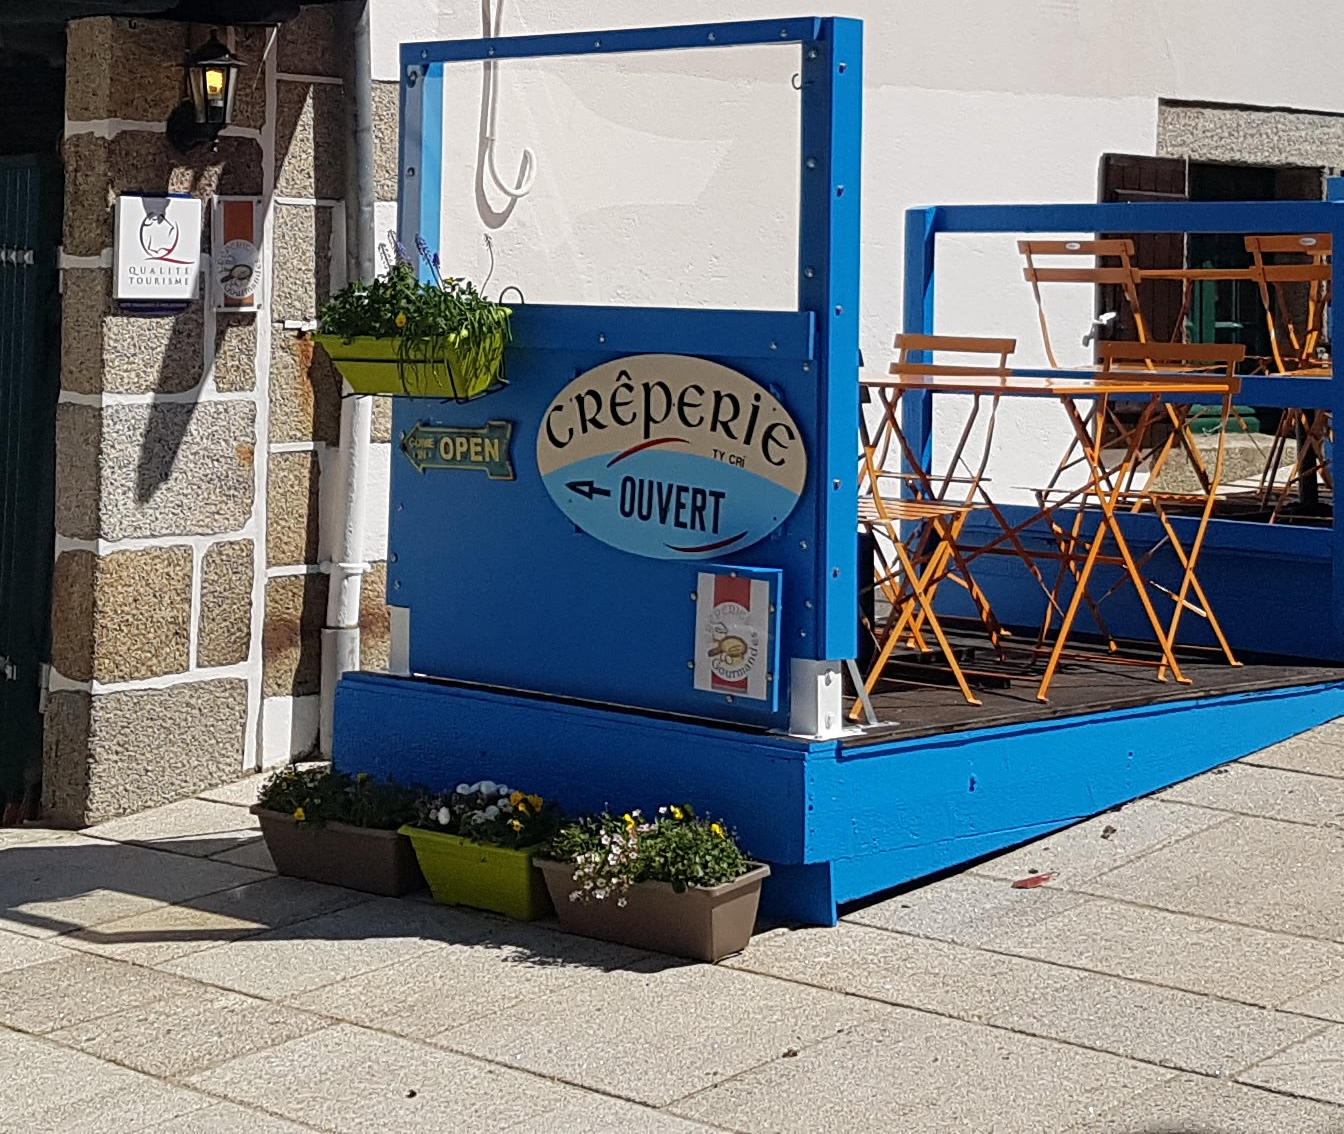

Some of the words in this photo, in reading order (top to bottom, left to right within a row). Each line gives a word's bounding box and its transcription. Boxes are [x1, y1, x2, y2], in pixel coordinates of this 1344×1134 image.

[129, 277, 189, 286] TOURISME
[439, 436, 500, 463] OPEN
[712, 448, 726, 461] TY
[619, 475, 726, 535] OUVERT
